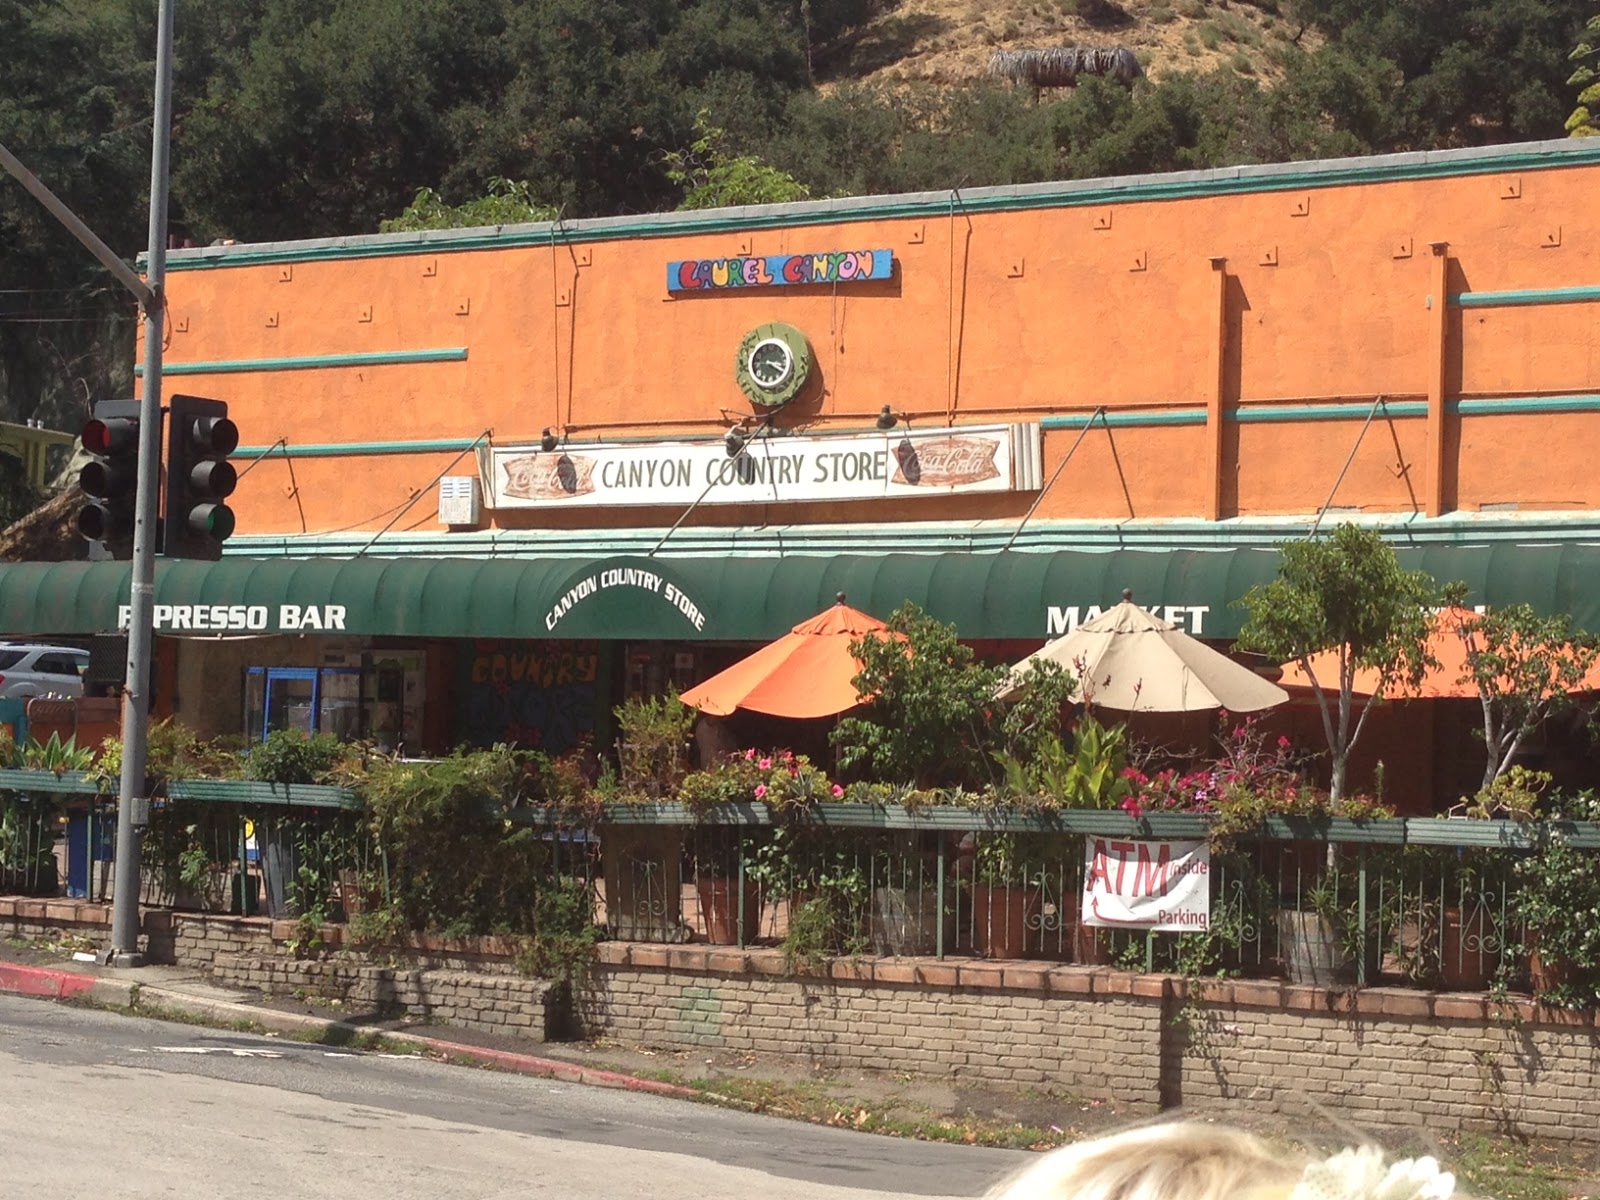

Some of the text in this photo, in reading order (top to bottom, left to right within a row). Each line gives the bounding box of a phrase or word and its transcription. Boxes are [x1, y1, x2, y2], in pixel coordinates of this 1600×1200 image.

[678, 250, 874, 289] LAUREL CANYON
[602, 450, 887, 488] CANYON COUNTRY STORE
[118, 604, 346, 630] EPRESSO BAR
[545, 567, 706, 632] CANYON COUNTRY STORE
[1086, 839, 1170, 898] ATM
[1158, 907, 1207, 929] Parking
